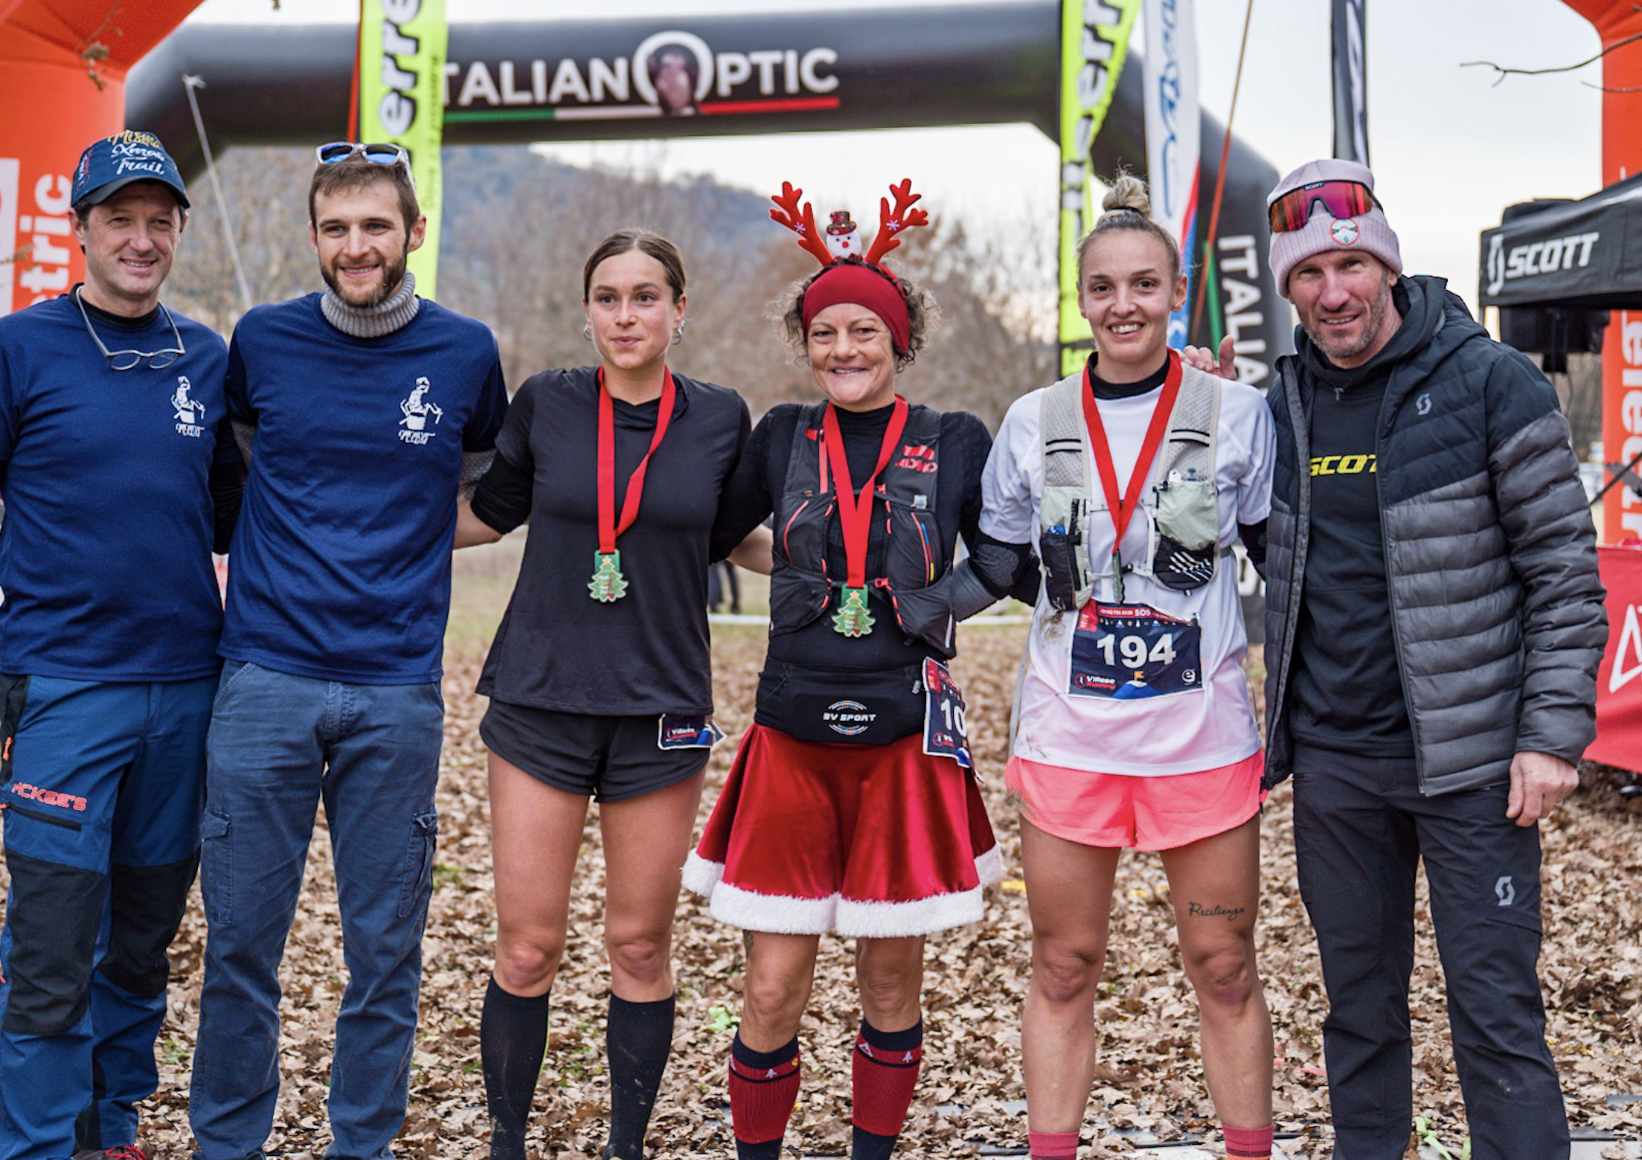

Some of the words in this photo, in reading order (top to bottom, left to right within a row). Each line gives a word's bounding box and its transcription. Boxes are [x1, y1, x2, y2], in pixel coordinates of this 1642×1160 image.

[443, 57, 630, 106] TALIAN
[112, 157, 165, 175] Trail
[19, 173, 72, 307] tric
[1505, 231, 1600, 279] SCOTT
[1217, 234, 1270, 398] ITALIA
[1096, 633, 1177, 669] 194
[840, 713, 877, 722] SPORT
